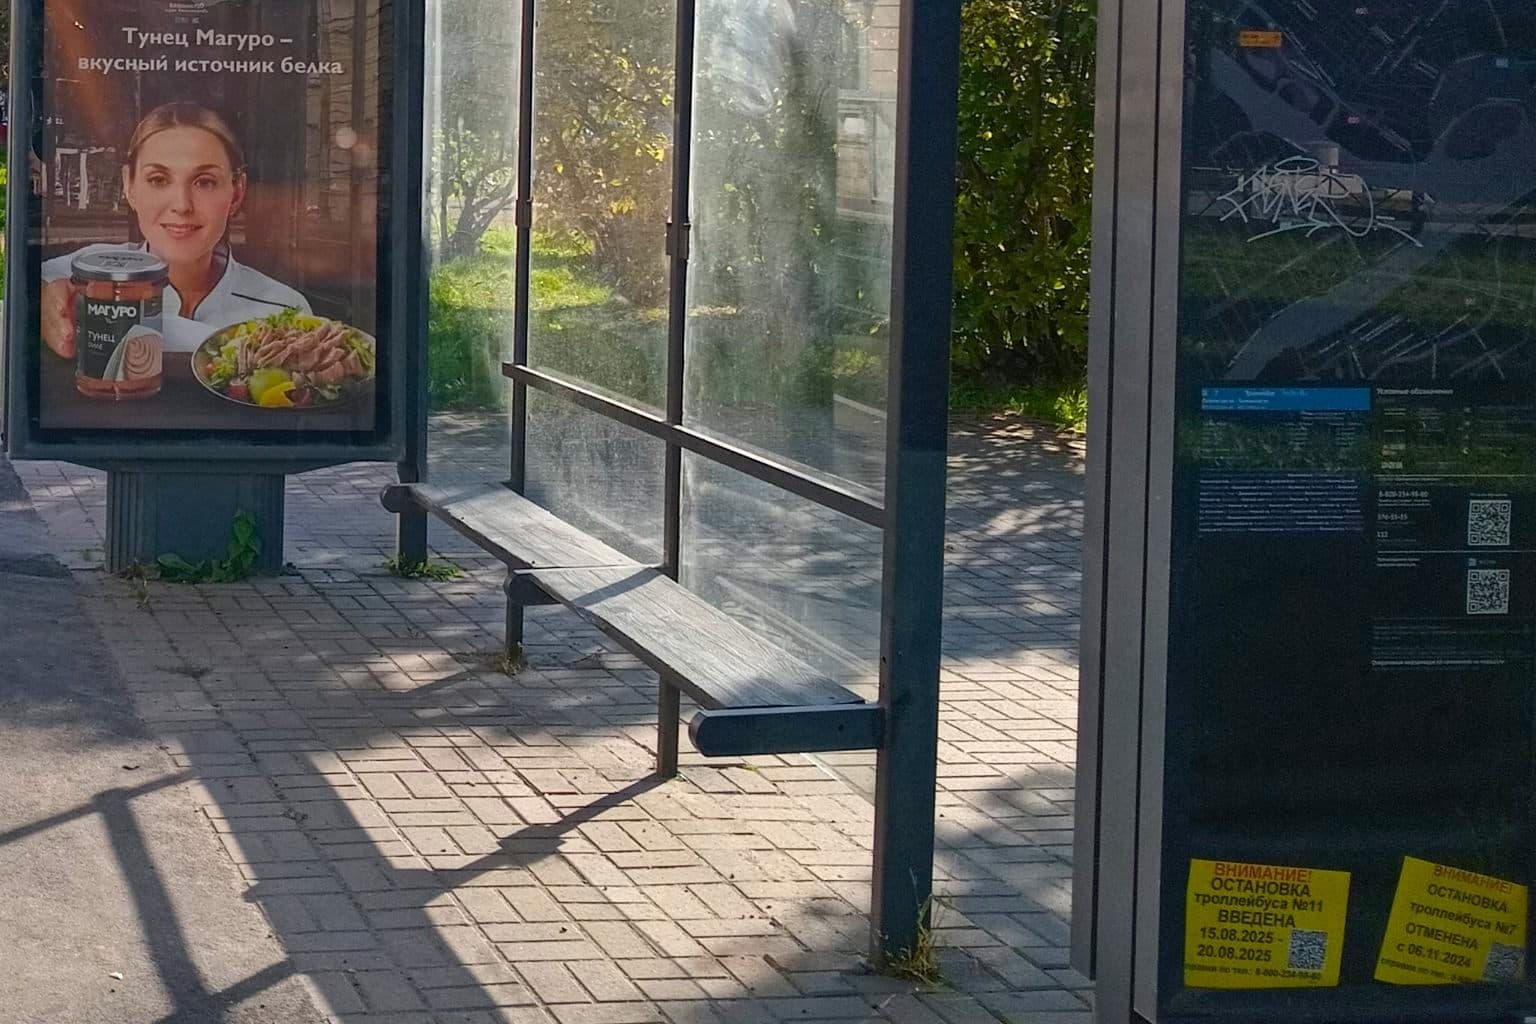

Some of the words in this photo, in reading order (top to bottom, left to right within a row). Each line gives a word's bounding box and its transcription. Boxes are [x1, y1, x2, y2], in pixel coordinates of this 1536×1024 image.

[122, 27, 189, 49] Тунец
[196, 28, 275, 51] Магуро
[78, 54, 168, 76] вкусный
[174, 58, 275, 74] источник
[280, 56, 343, 75] белка
[87, 303, 137, 320] МАГУРО
[87, 330, 116, 343] ТУНЕЦ
[1214, 863, 1313, 883] ВНИМАНИЕ!
[1433, 864, 1514, 895] ВНИМАНИЕ!
[1211, 877, 1311, 897] ОСТАНОВКА
[1194, 893, 1289, 911] троллейбуса
[1292, 899, 1323, 912] №11
[1427, 883, 1508, 913] ОСТАНОВКА
[1217, 909, 1296, 928] ВВЕДЕНА
[1409, 902, 1491, 929] троллейбуса
[1495, 920, 1518, 936] №7
[1199, 927, 1274, 944] 15.08.2025
[1405, 922, 1479, 951] ОТМЕНЕНА
[1197, 944, 1272, 962] 20.08.2025
[1396, 943, 1405, 952] с
[1407, 943, 1472, 969] 06.11.2024
